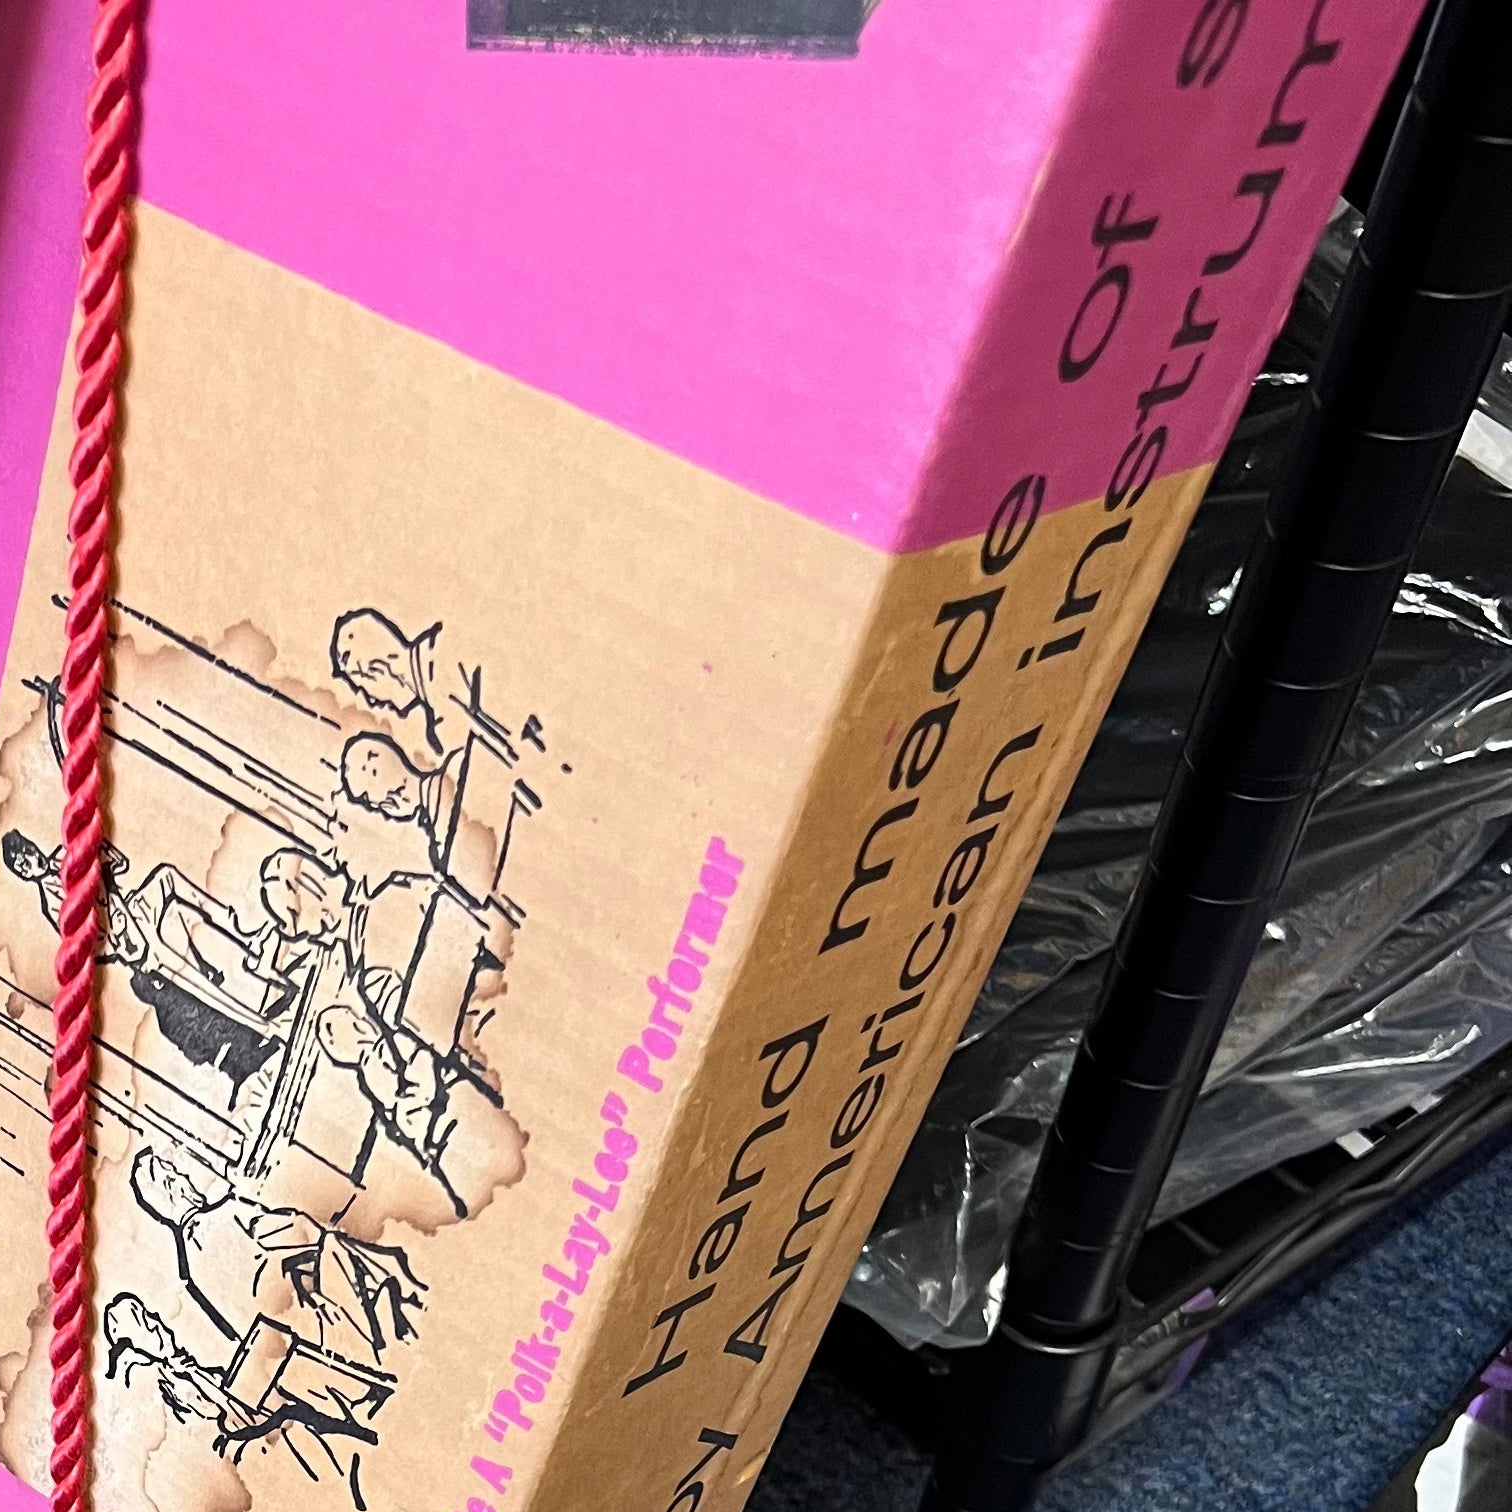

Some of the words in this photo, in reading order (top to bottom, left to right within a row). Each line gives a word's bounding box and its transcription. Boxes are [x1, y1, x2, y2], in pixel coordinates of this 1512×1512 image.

[621, 1013, 830, 1398] Hand
[818, 474, 1046, 956] made
[1059, 194, 1159, 384] of
[723, 723, 1044, 1364] American
[470, 1456, 513, 1494] A
[617, 836, 745, 1093] Performer
